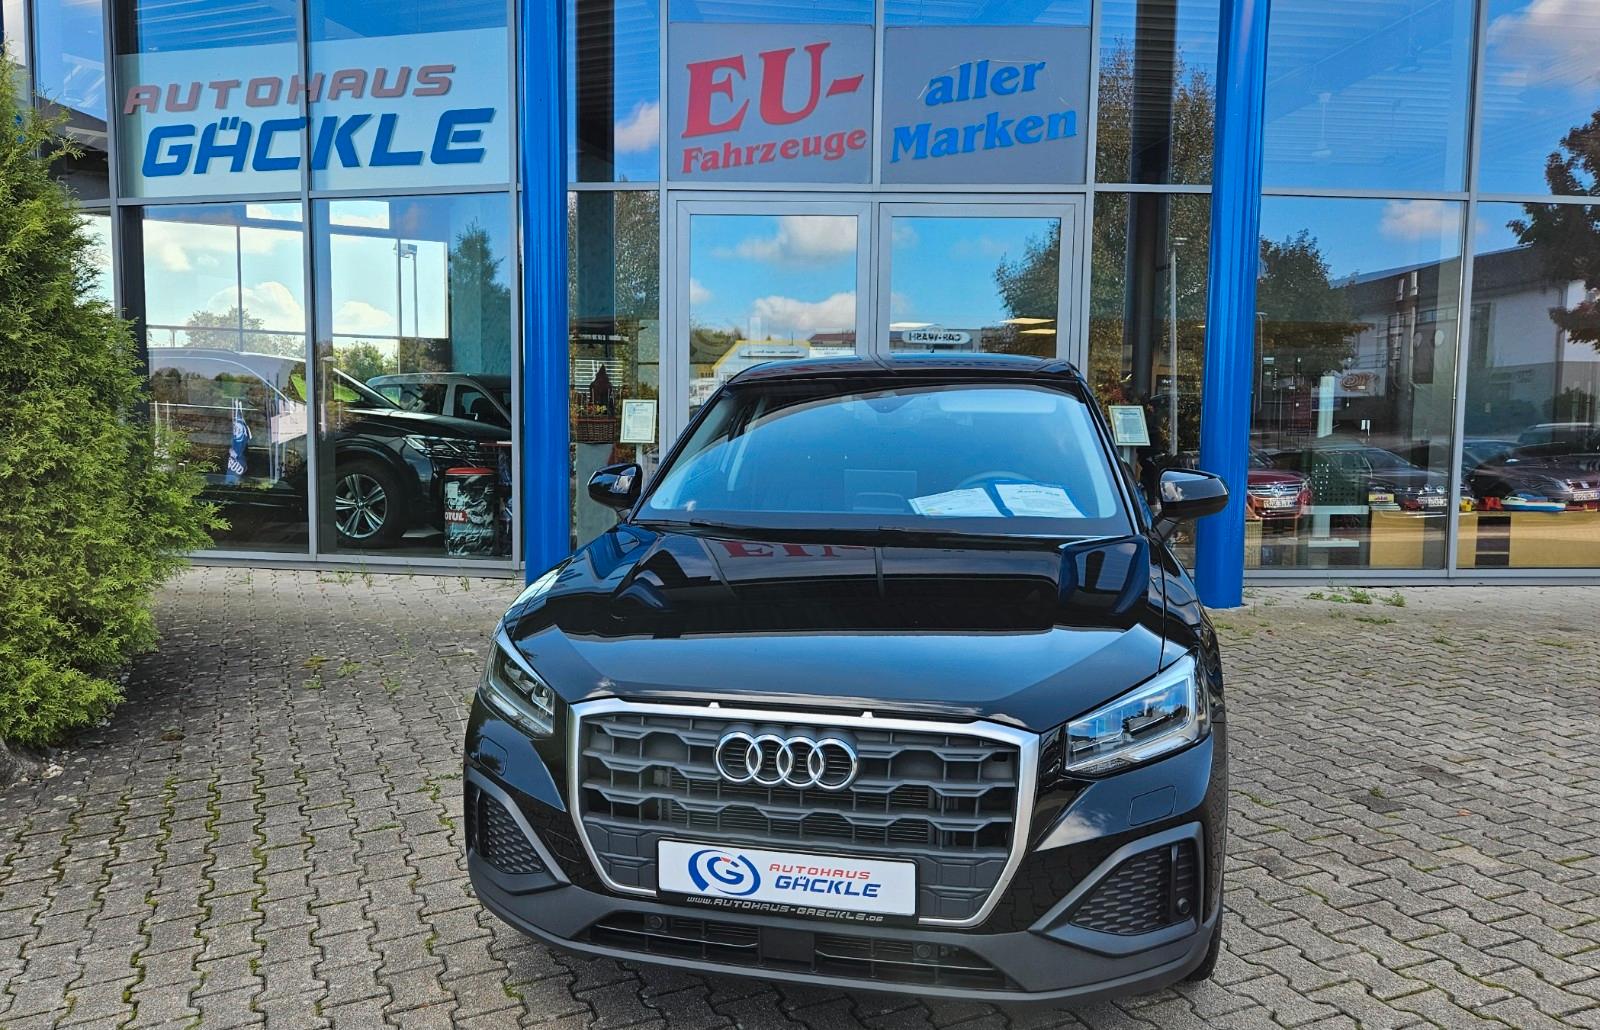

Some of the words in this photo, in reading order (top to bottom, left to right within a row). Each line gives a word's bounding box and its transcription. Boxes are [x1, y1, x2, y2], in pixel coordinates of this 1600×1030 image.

[123, 64, 455, 115] AUTOHAUS
[681, 42, 864, 138] EU-
[925, 59, 1046, 106] aller
[142, 107, 495, 178] GÄCKLE
[682, 129, 867, 174] Fahrzeuge
[890, 110, 1077, 164] Marken
[769, 863, 871, 880] AUTOHAUS
[775, 875, 882, 898] GÄCKLE
